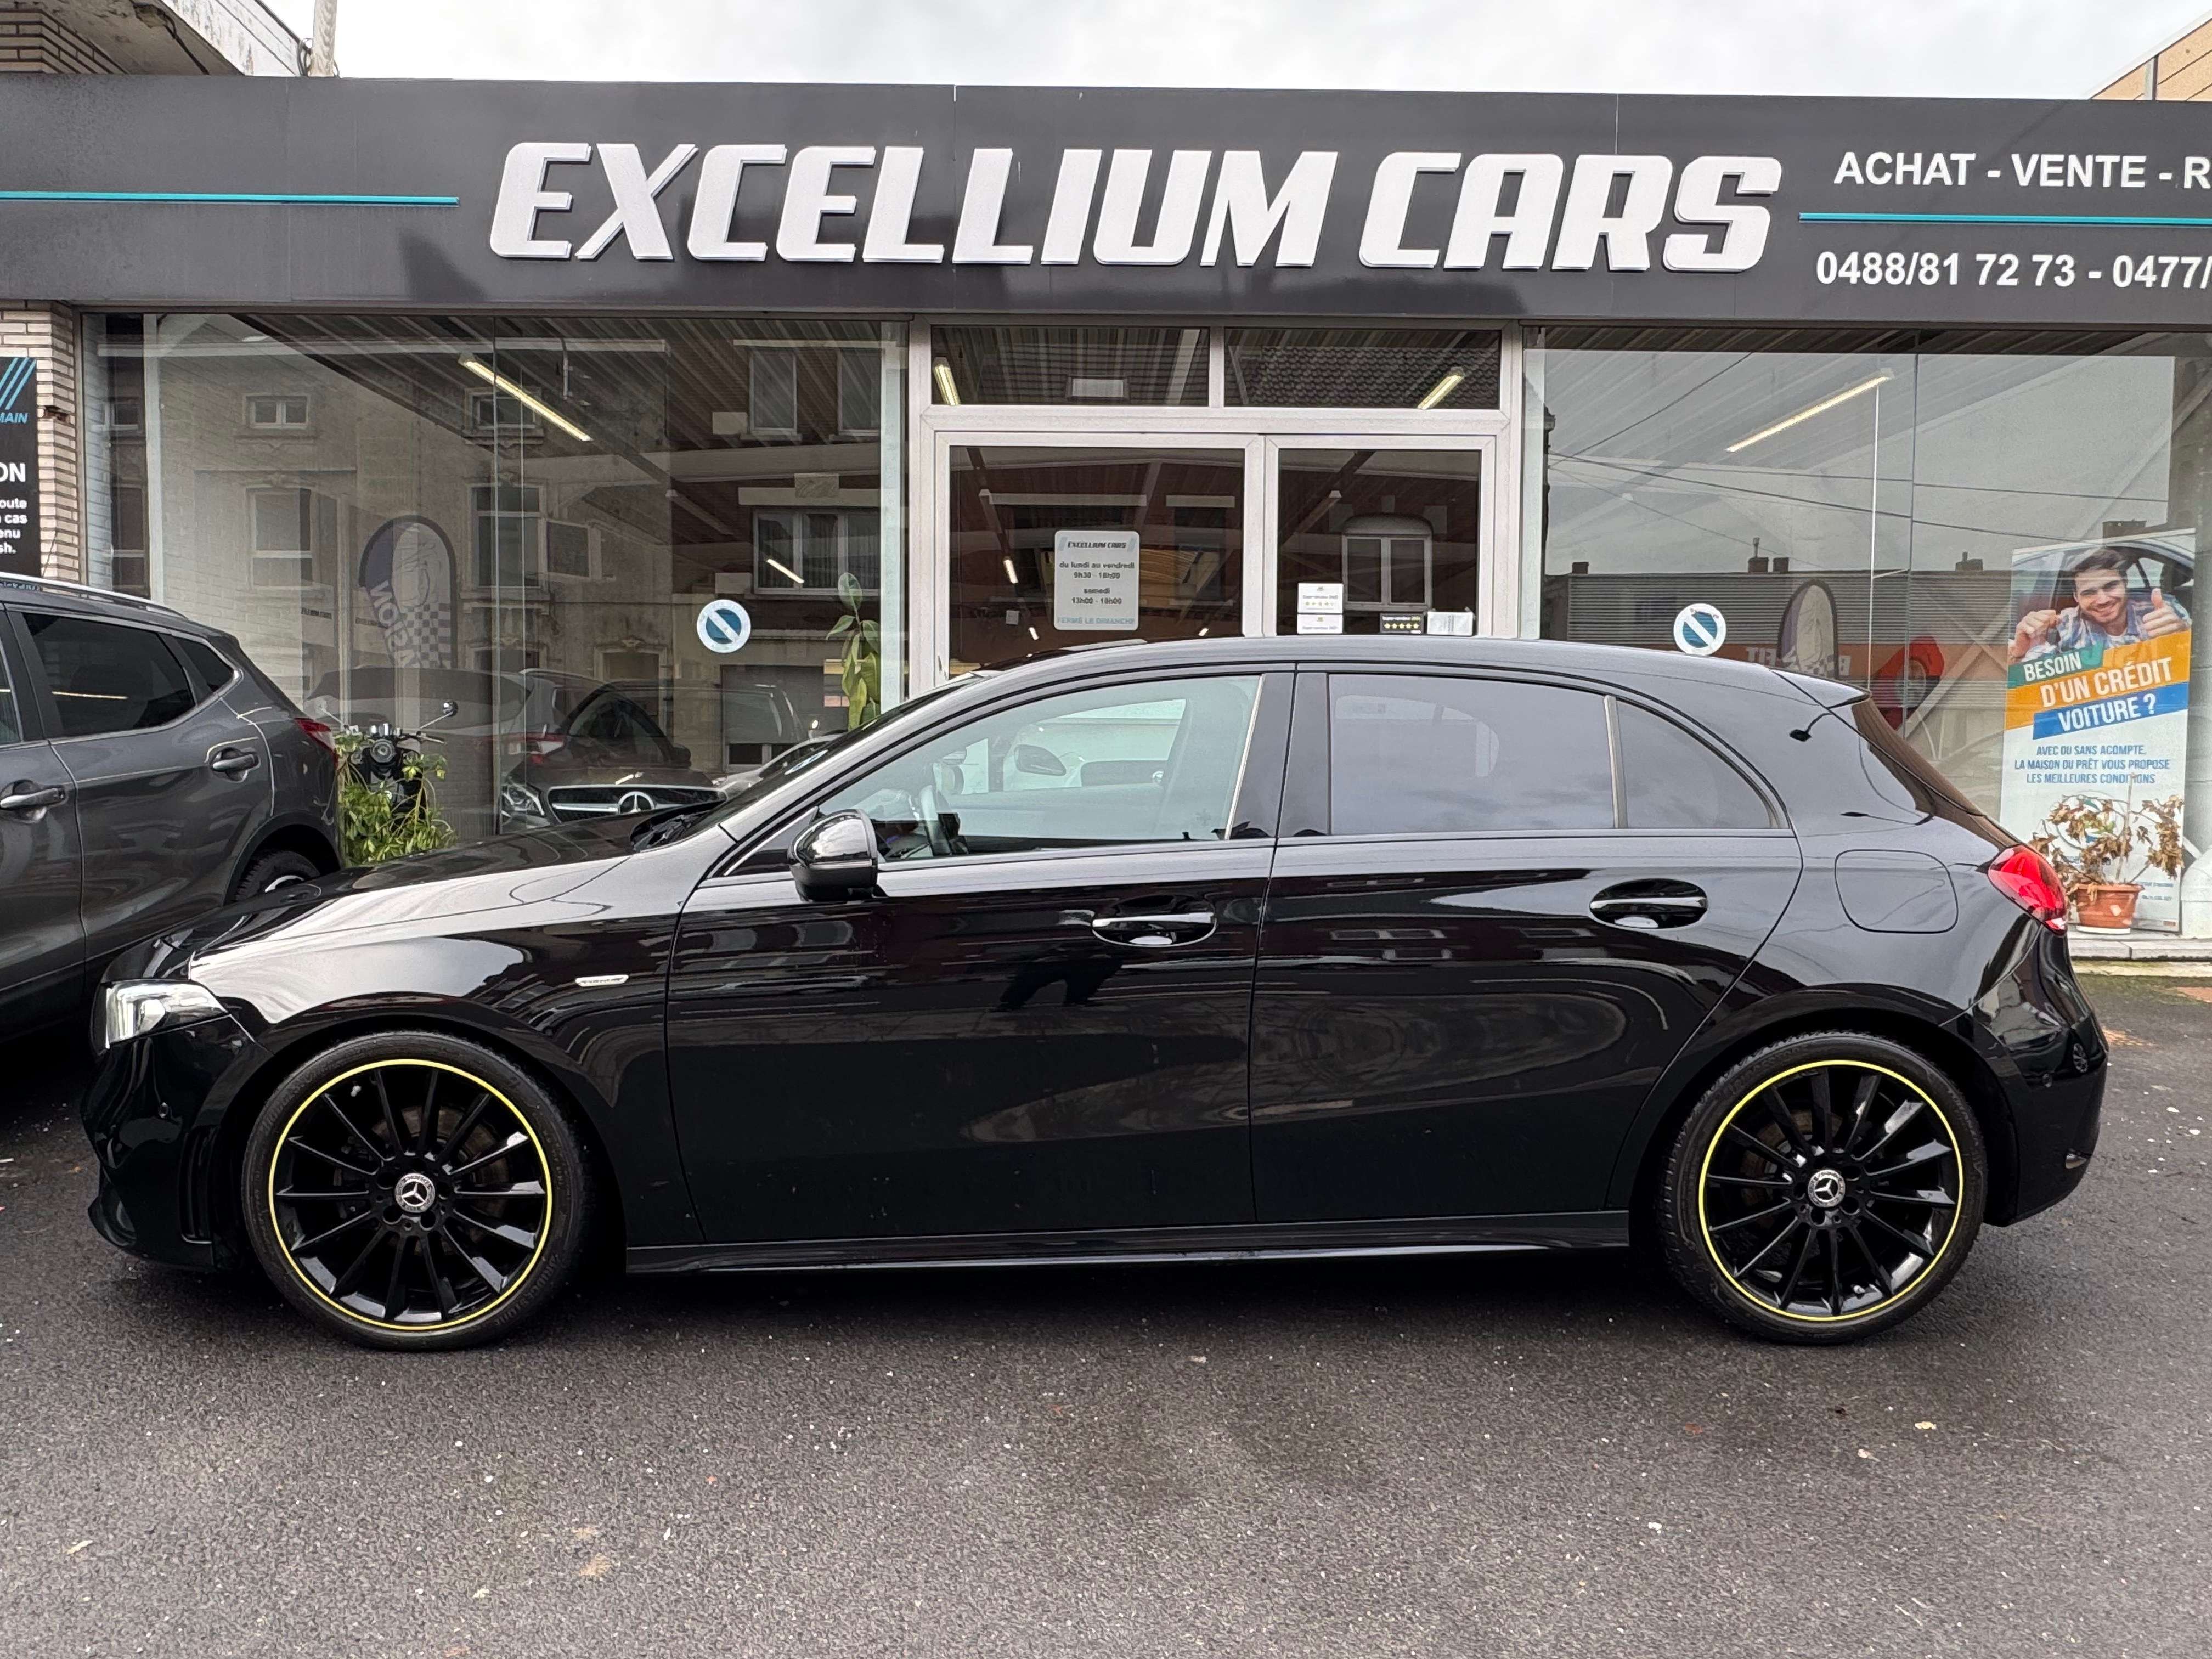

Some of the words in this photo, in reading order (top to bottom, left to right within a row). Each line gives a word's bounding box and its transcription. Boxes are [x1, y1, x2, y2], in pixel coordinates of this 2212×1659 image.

[1833, 152, 1976, 186] ACHAT
[2011, 154, 2147, 188] VENTE
[489, 142, 1339, 267] EXCELLIUM
[1358, 151, 1782, 272] CARS
[1816, 251, 1959, 285] 0488/81
[1975, 253, 2019, 286] 72
[2031, 255, 2076, 287] 73
[2112, 255, 2212, 289] 0477/
[2023, 652, 2081, 682] BESOIN
[2040, 675, 2091, 708] D'UN
[2093, 657, 2172, 696] CRÉDIT
[2057, 696, 2141, 732] VOITURE
[2143, 693, 2156, 714] ?
[2015, 760, 2025, 769] LA
[2028, 759, 2060, 769] MAISON
[2063, 759, 2074, 769] DU
[2076, 758, 2099, 769] PRÊT
[2101, 759, 2126, 769] VOUS
[2128, 759, 2171, 769] PROPOSE
[2036, 746, 2058, 755] AVEC
[2061, 746, 2072, 755] OU
[2074, 745, 2097, 755] SANS
[2027, 774, 2042, 783] LES
[2044, 774, 2098, 783] MEILLEURES
[2100, 774, 2156, 783] CONDIIONS
